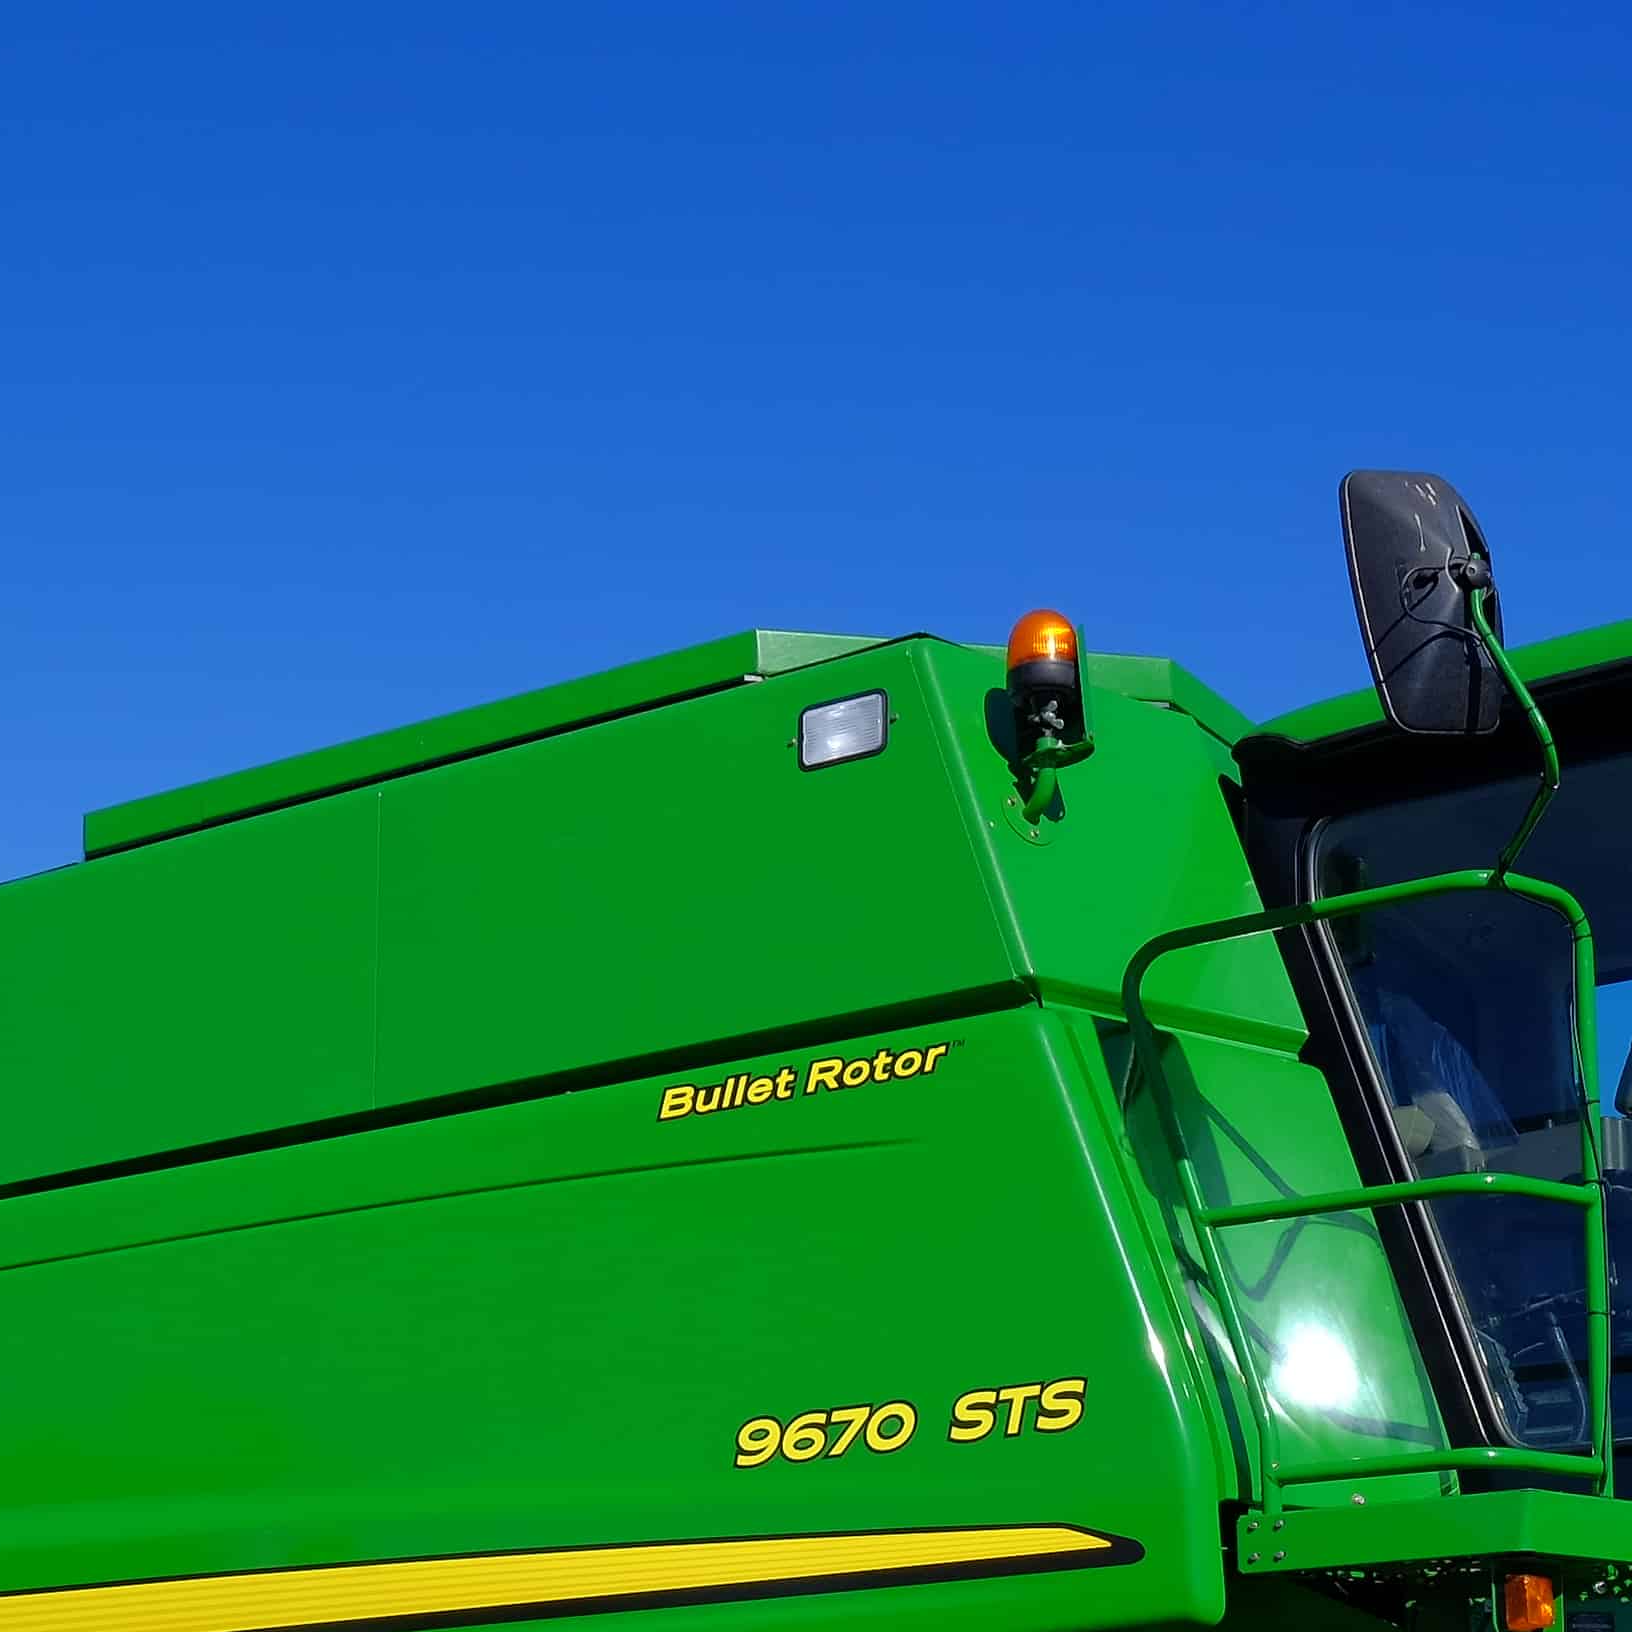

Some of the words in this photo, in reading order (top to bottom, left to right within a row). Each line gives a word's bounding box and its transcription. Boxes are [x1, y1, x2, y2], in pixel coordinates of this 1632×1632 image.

[658, 1068, 794, 1121] Bullet
[733, 1402, 917, 1469] 9670
[949, 1376, 1087, 1442] STS
